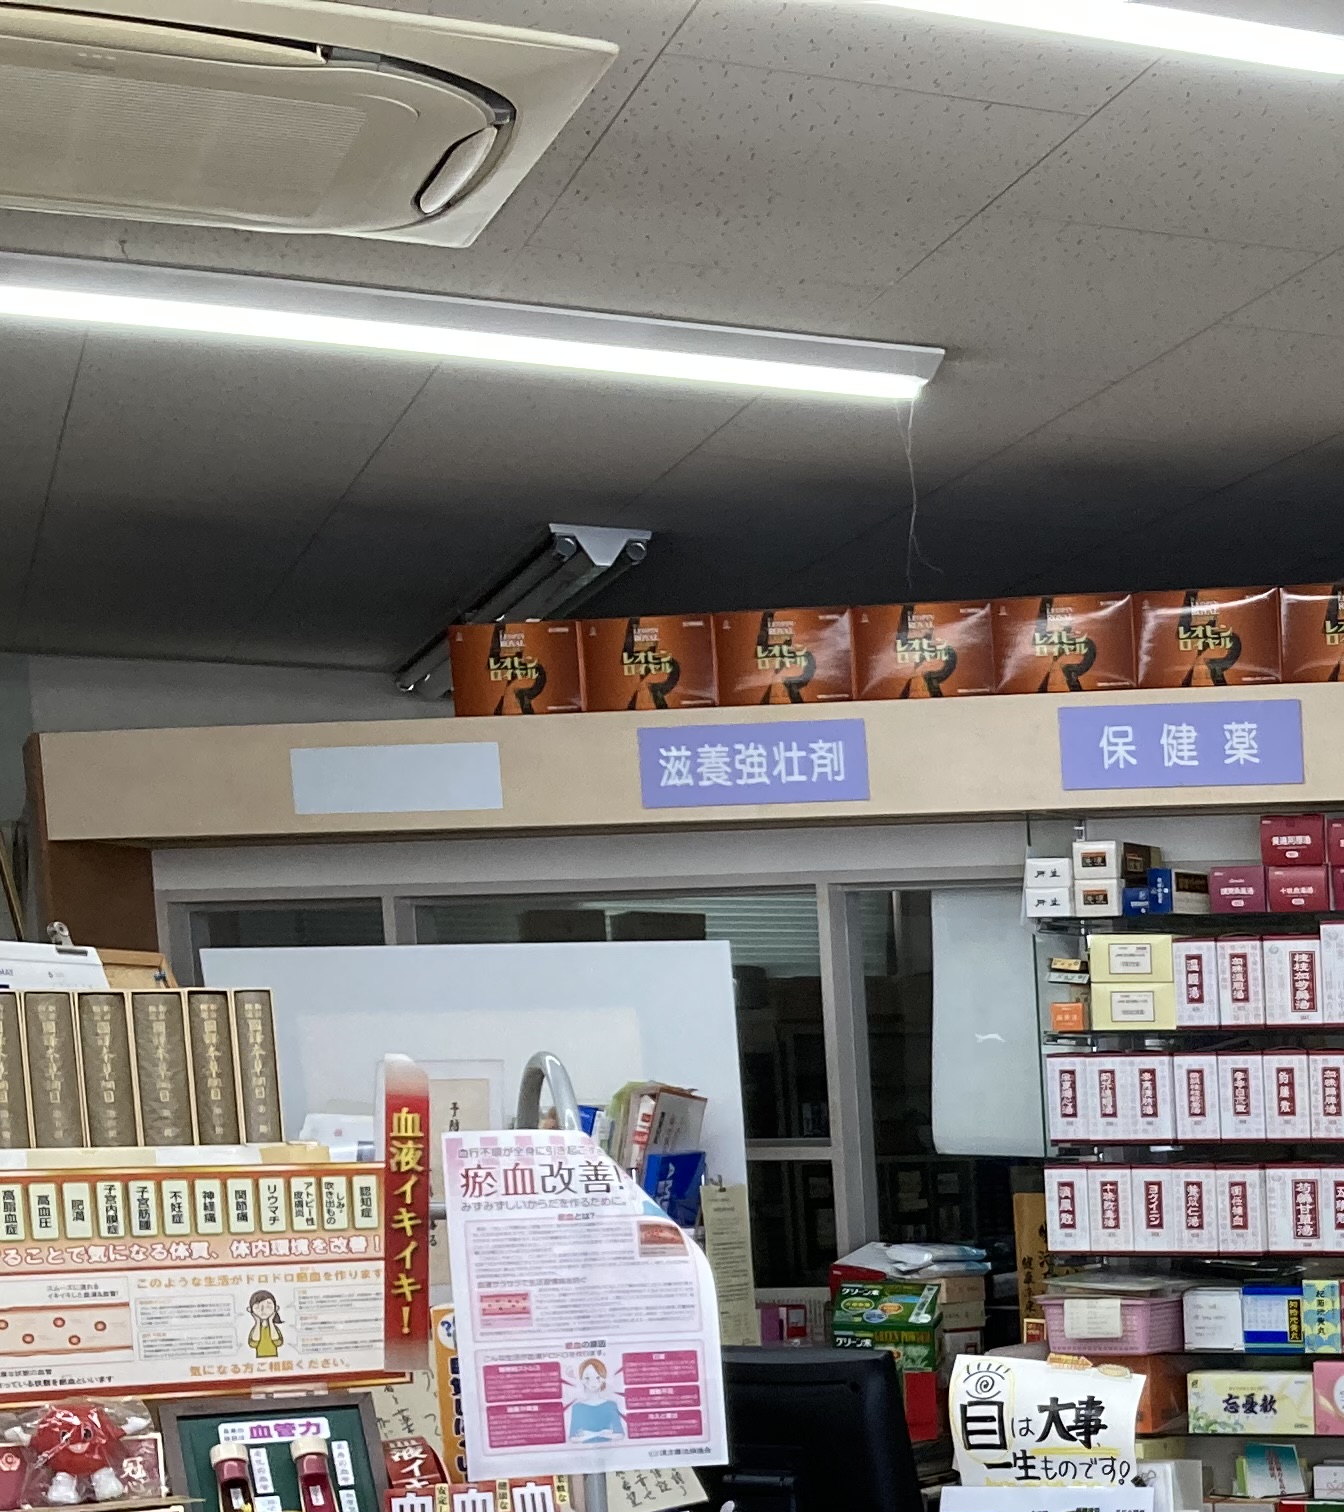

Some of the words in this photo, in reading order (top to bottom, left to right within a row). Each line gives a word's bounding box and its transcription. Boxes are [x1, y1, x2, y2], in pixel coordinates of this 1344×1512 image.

[659, 739, 846, 788] 滋養強壮剤
[1098, 722, 1261, 769] 保健薬
[266, 1184, 279, 1226] リウマチ
[387, 1107, 426, 1336] 血液イキイキ！
